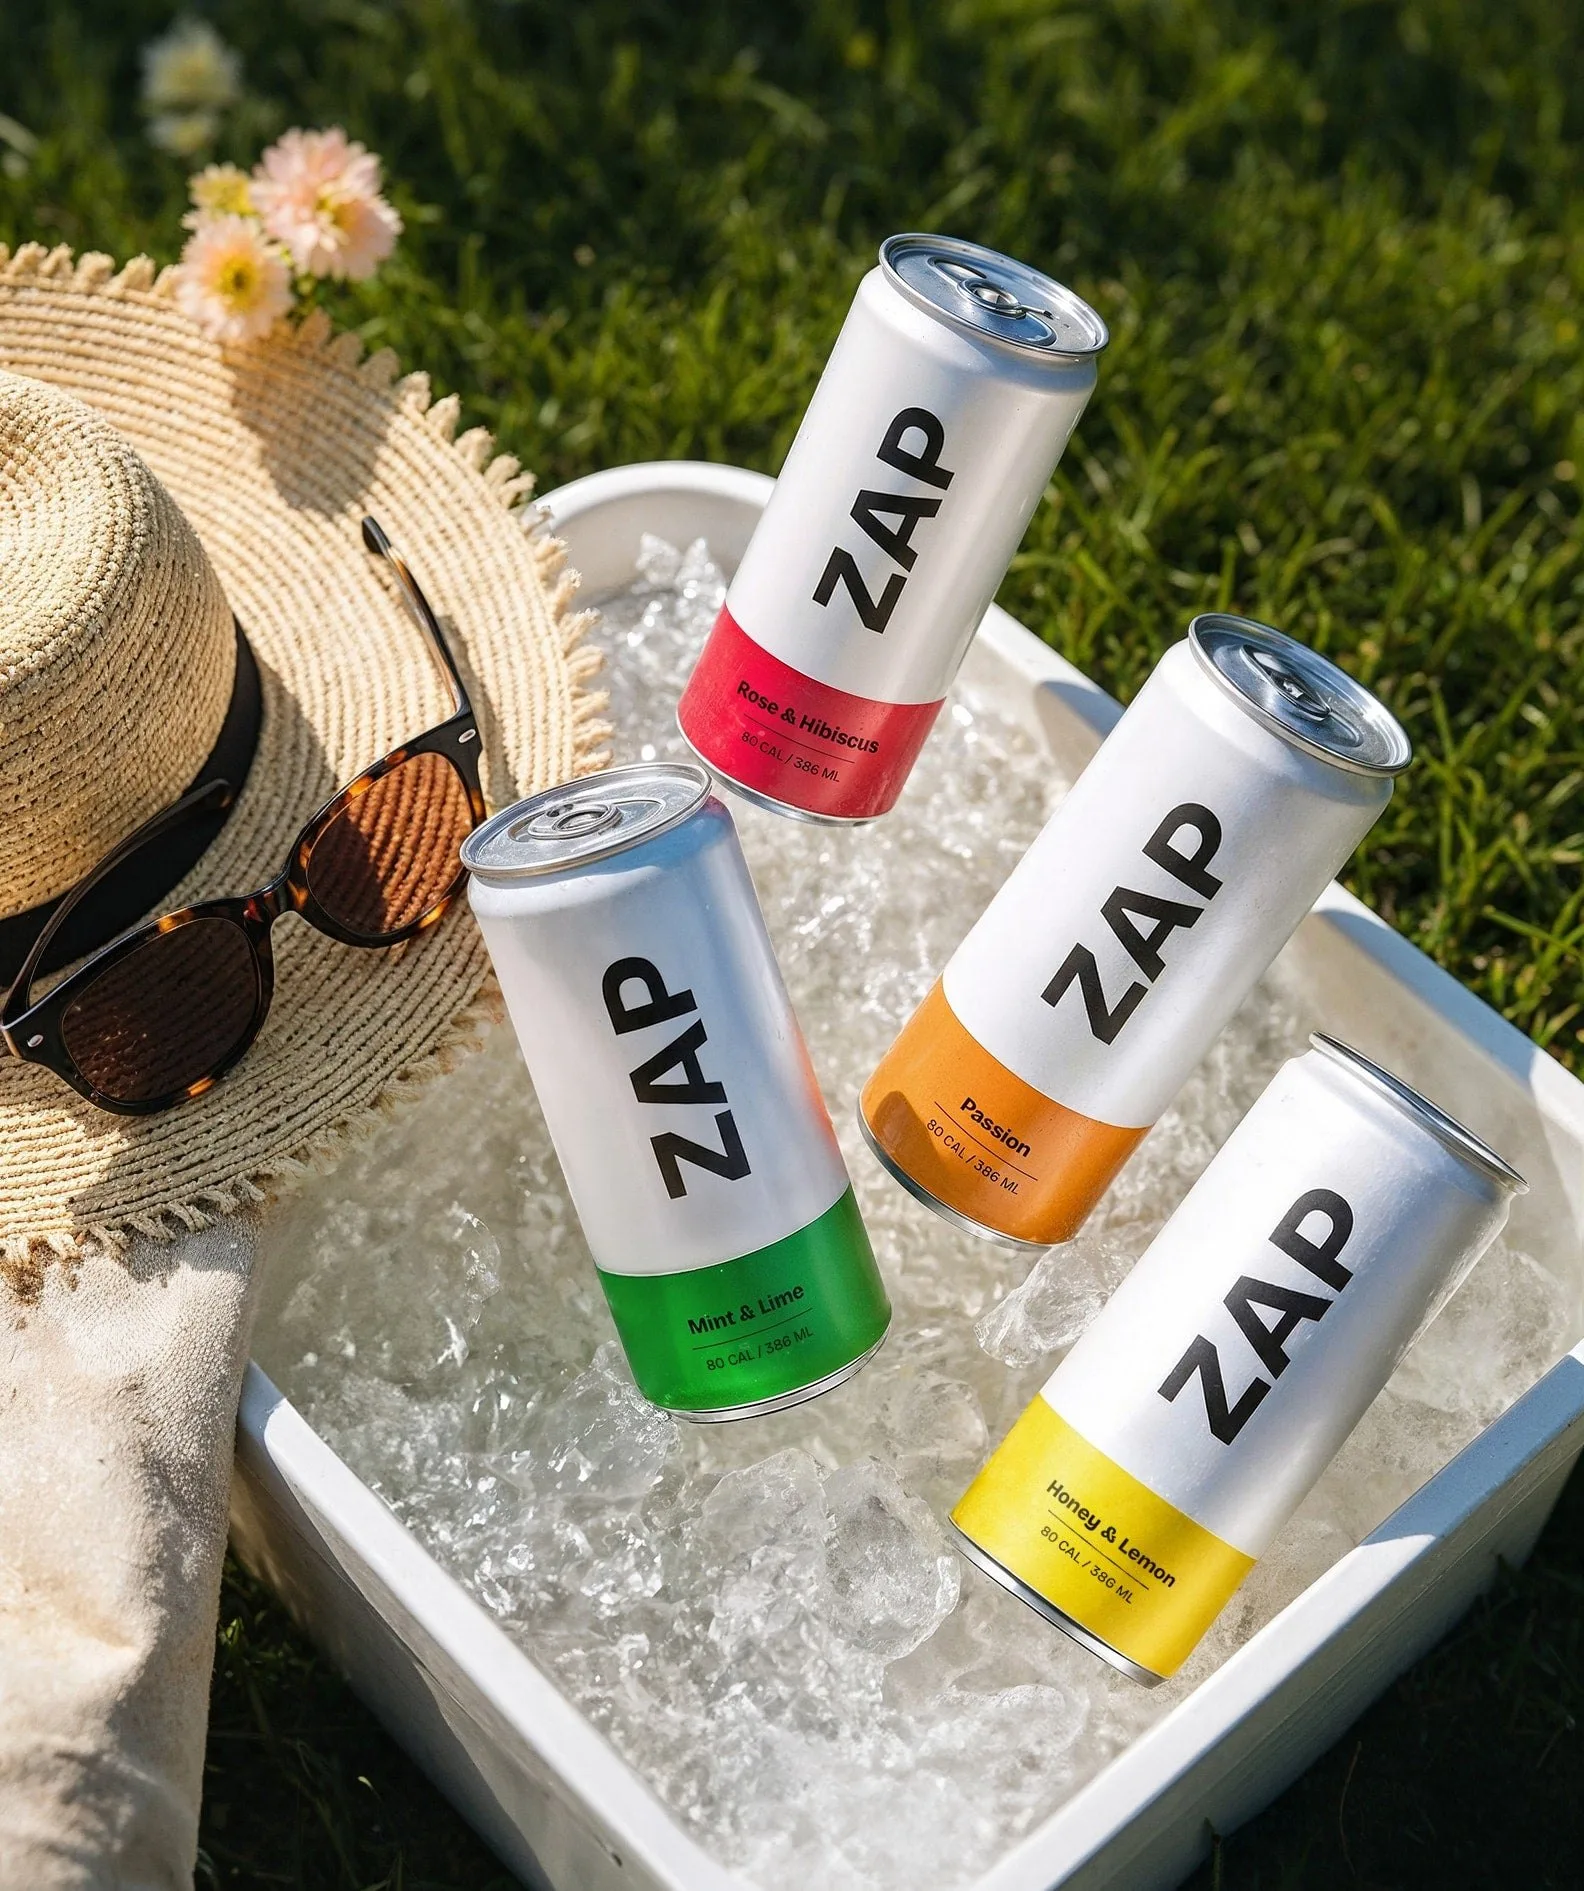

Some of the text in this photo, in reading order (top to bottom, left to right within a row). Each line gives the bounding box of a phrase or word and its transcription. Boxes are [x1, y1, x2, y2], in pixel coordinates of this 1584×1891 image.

[813, 408, 954, 633] ZAP
[737, 680, 879, 754] Rose & Hibiscus
[741, 731, 758, 747] 80
[759, 741, 784, 761] CAL
[793, 757, 819, 776] 386
[821, 767, 840, 783] ML
[1041, 803, 1223, 1045] ZAP
[602, 957, 751, 1199] ZAP
[926, 1119, 943, 1138] 80
[943, 1135, 966, 1160] CAL
[973, 1160, 1000, 1182] 386
[1000, 1177, 1019, 1195] ML
[960, 1097, 1032, 1158] Passion
[688, 1284, 805, 1335] Mint & Lime
[1162, 1189, 1353, 1445] ZAP
[706, 1357, 725, 1371] 80
[728, 1349, 754, 1366] CAL
[766, 1336, 791, 1355] 386
[794, 1326, 814, 1341] ML
[1040, 1526, 1058, 1543] 80
[1058, 1540, 1082, 1564] CAL
[1090, 1565, 1116, 1589] 386
[1115, 1585, 1132, 1604] ML
[1046, 1480, 1176, 1588] Honey & Lemon
